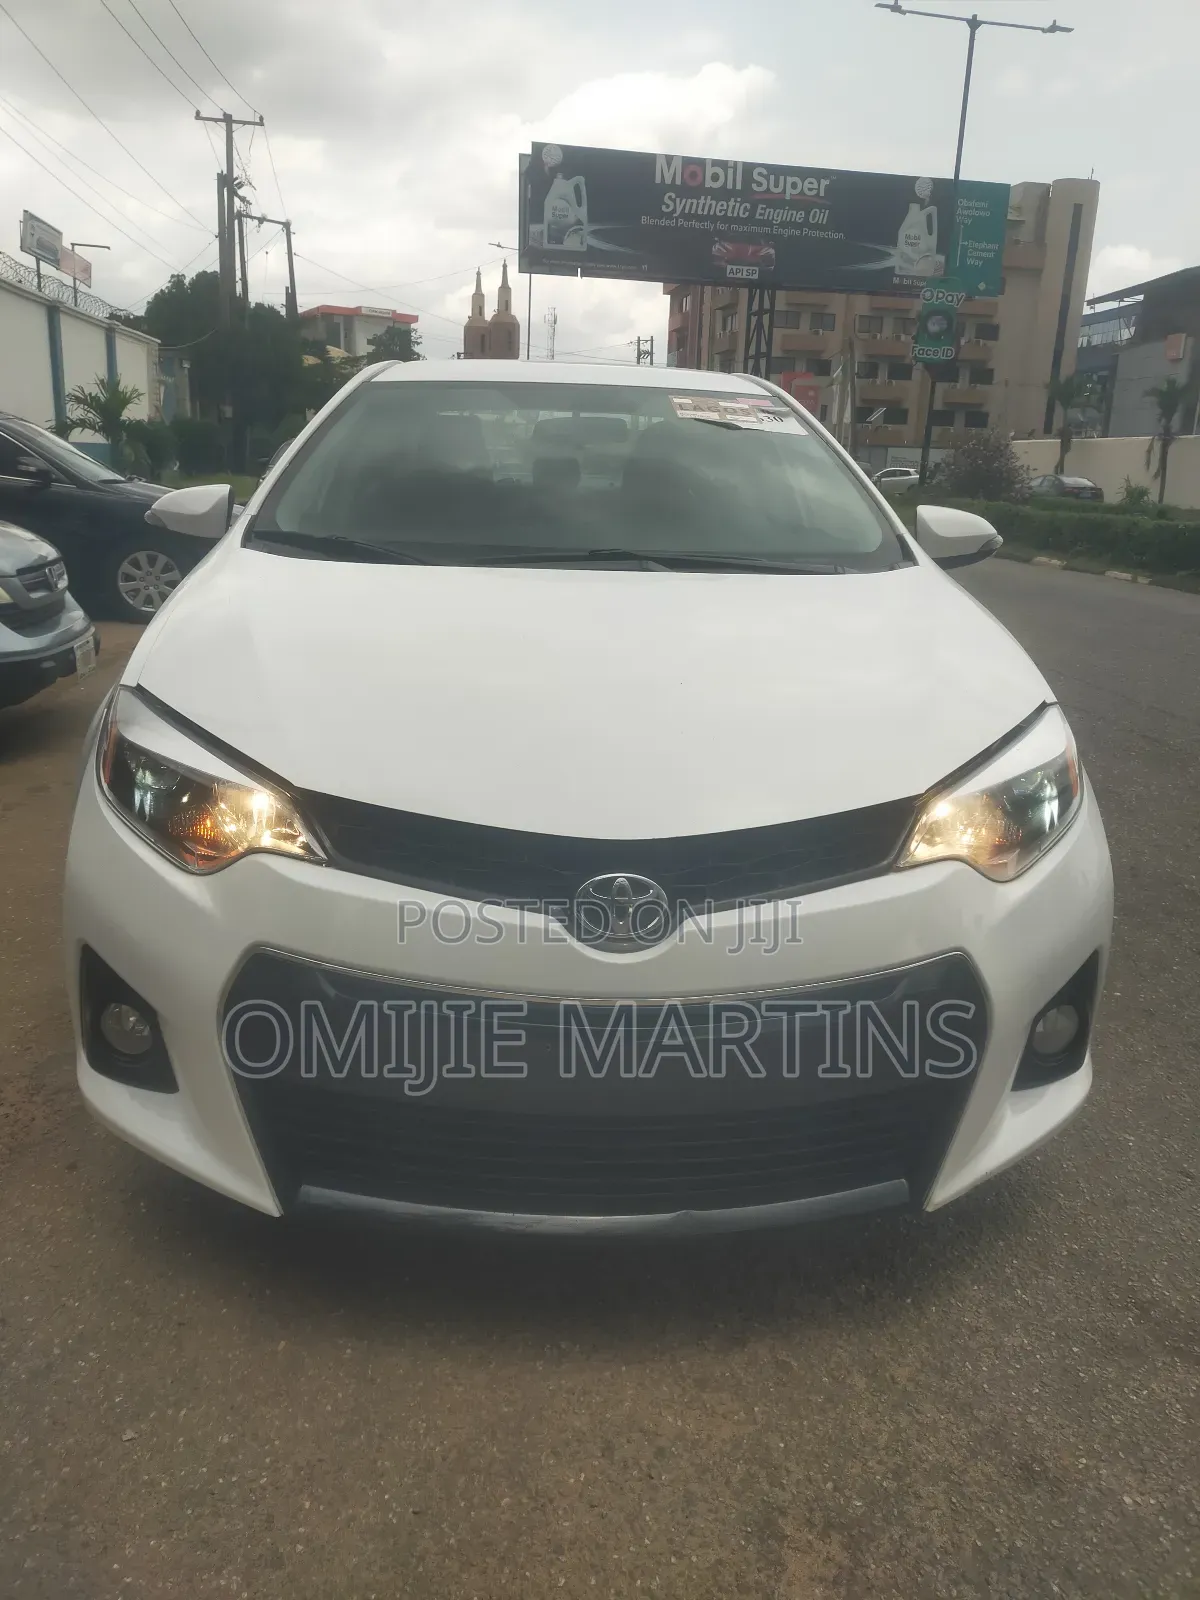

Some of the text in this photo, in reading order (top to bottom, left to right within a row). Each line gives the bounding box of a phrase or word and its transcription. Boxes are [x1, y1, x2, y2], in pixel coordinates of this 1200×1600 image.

[654, 153, 830, 200] Mobil Super
[661, 192, 830, 225] Synthetic Engine Oil
[957, 199, 989, 208] Obafemi
[956, 207, 991, 217] Awolowo
[956, 216, 973, 225] Way
[641, 215, 847, 240] Blended Perfectly for maximum Engine Protection.
[967, 240, 999, 250] Elephant
[967, 249, 996, 258] Cement
[966, 258, 984, 268] Way
[728, 267, 758, 278] API SP
[921, 288, 965, 307] OPay
[911, 344, 955, 360] Face ID
